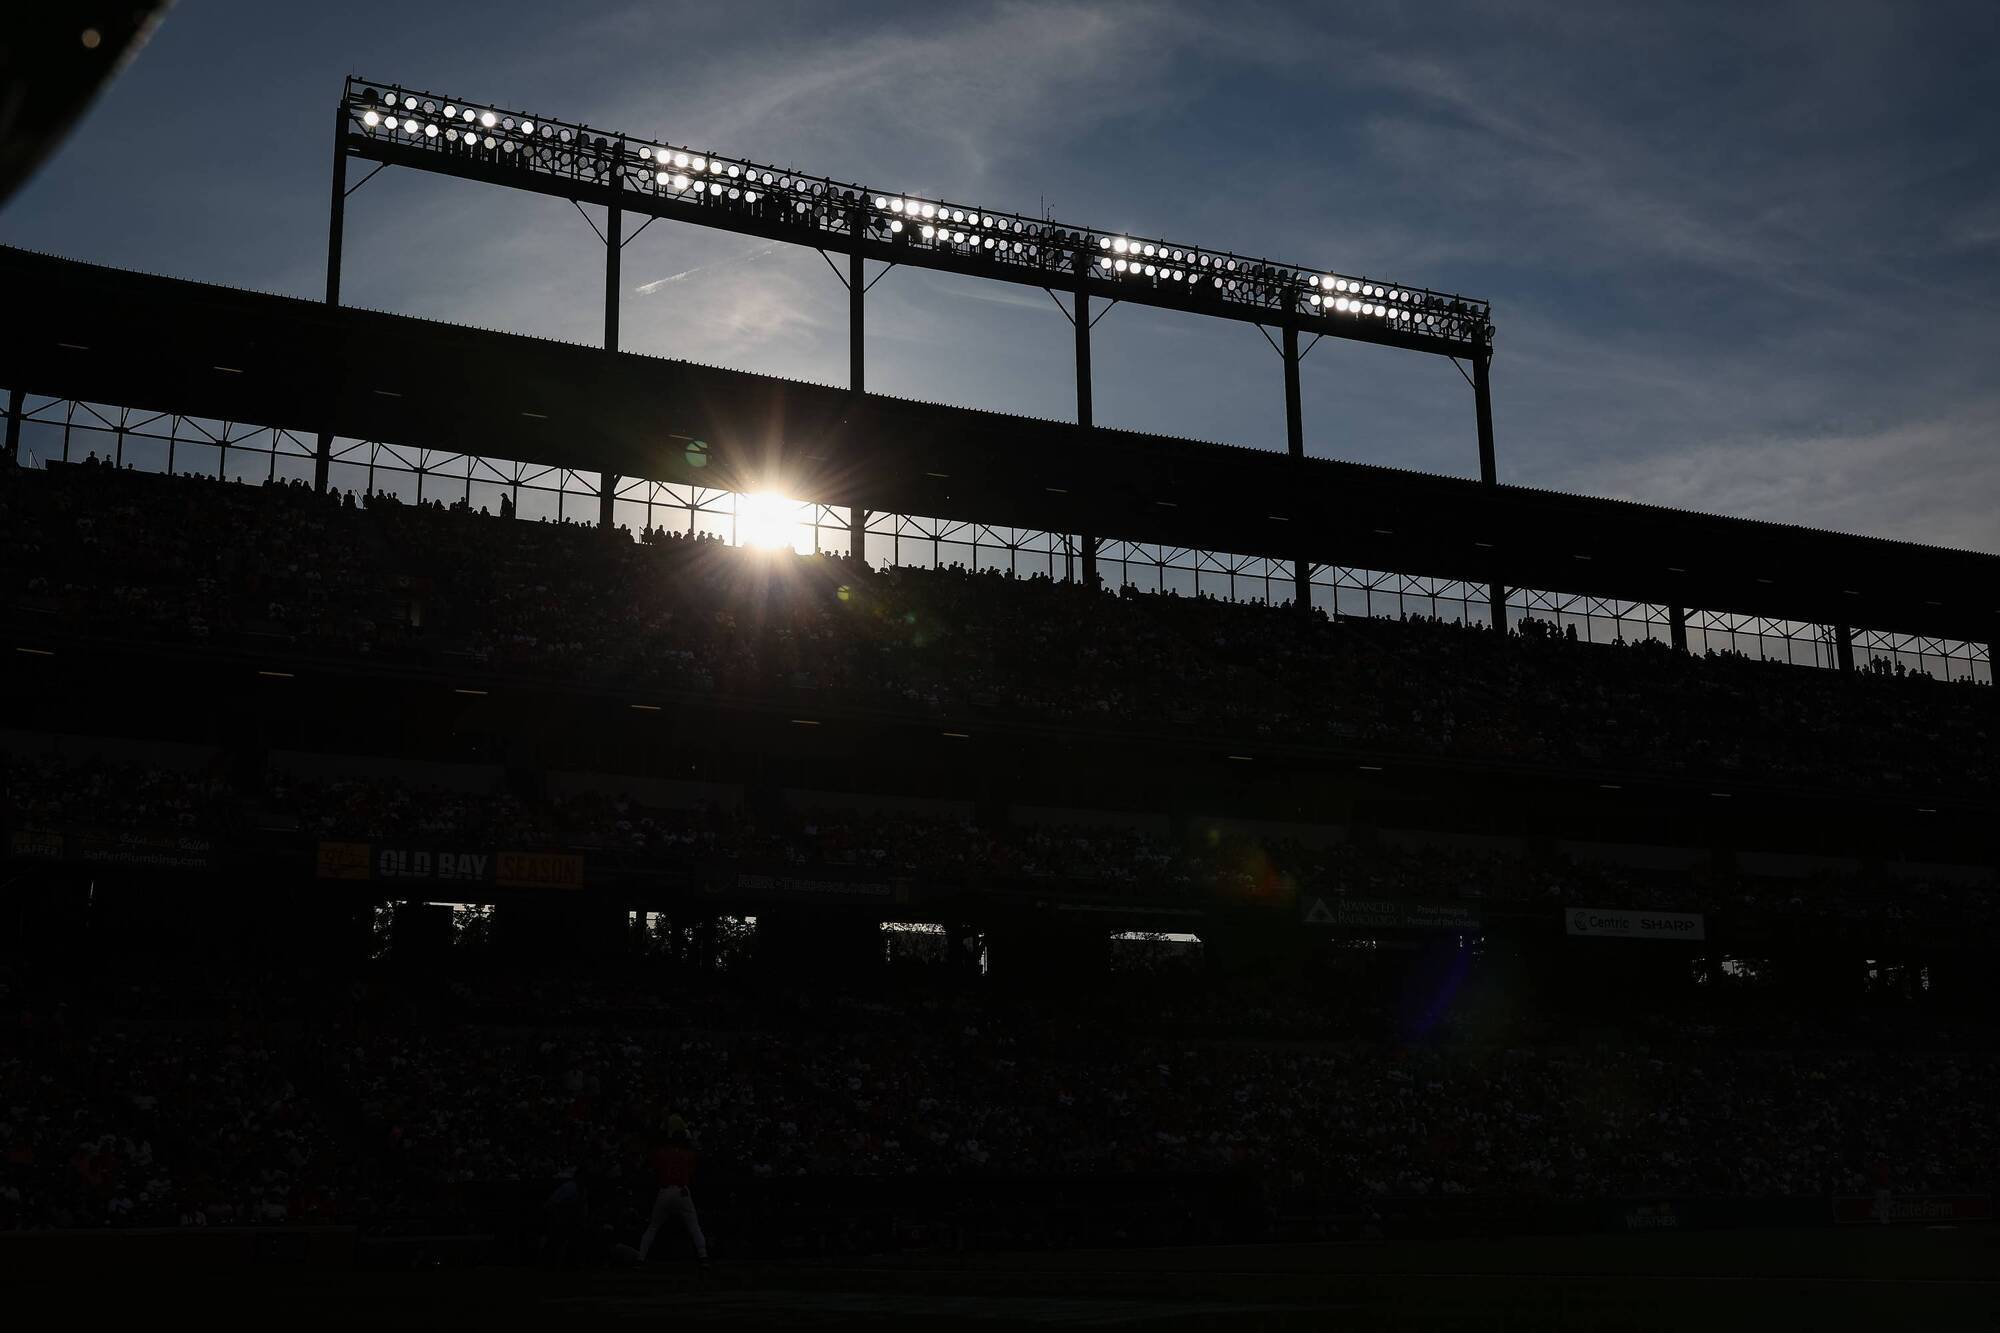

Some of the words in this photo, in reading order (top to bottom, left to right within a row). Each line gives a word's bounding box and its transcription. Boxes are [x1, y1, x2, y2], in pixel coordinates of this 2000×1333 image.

[82, 849, 208, 868] SafferPlumbing.com
[379, 849, 432, 878] OLD
[438, 852, 488, 881] BAY
[504, 855, 576, 883] SEASON
[1338, 899, 1395, 914] ADVANCED
[1590, 915, 1630, 930] Centric
[1641, 918, 1695, 932] SHARP
